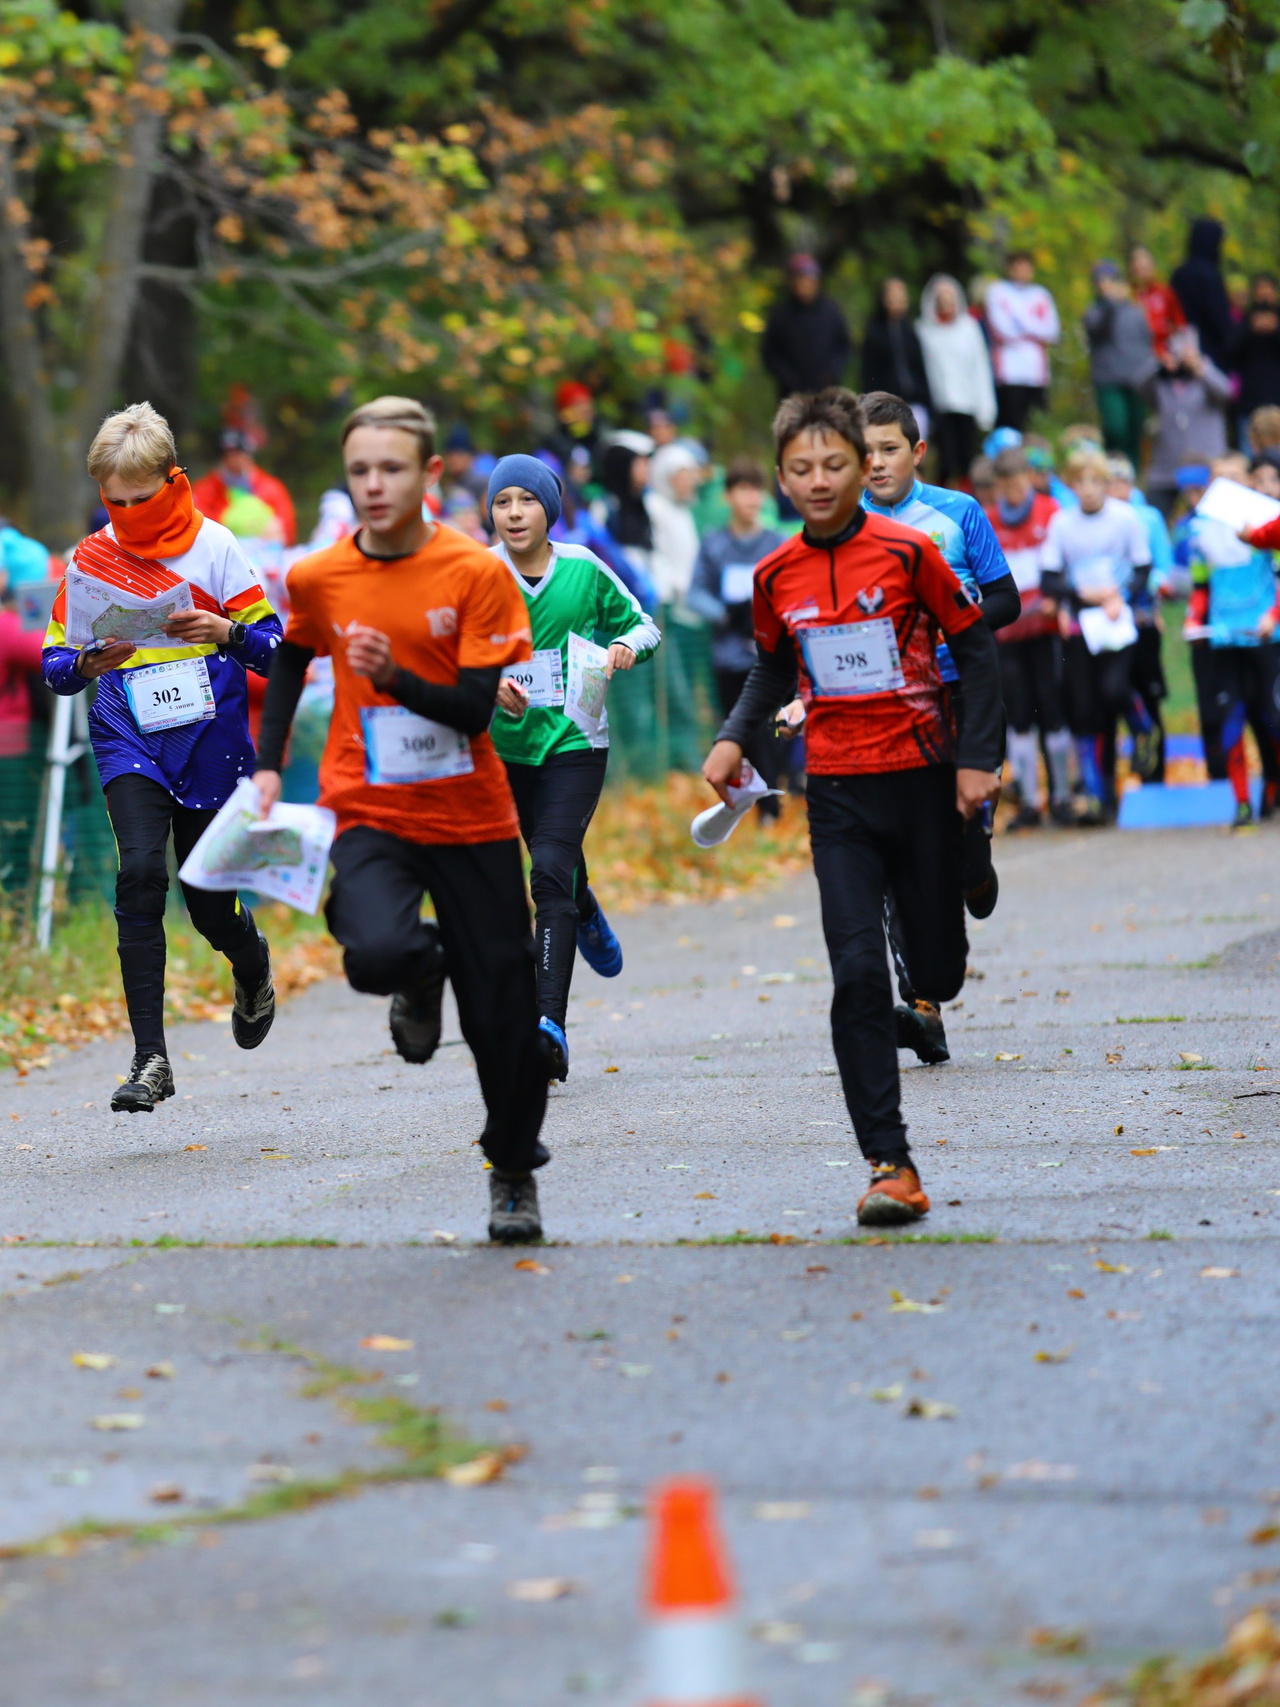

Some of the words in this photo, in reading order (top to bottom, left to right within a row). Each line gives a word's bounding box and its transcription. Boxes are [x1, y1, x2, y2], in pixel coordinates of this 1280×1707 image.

[835, 652, 868, 671] 298
[152, 687, 181, 707] 302
[400, 734, 436, 754] 300
